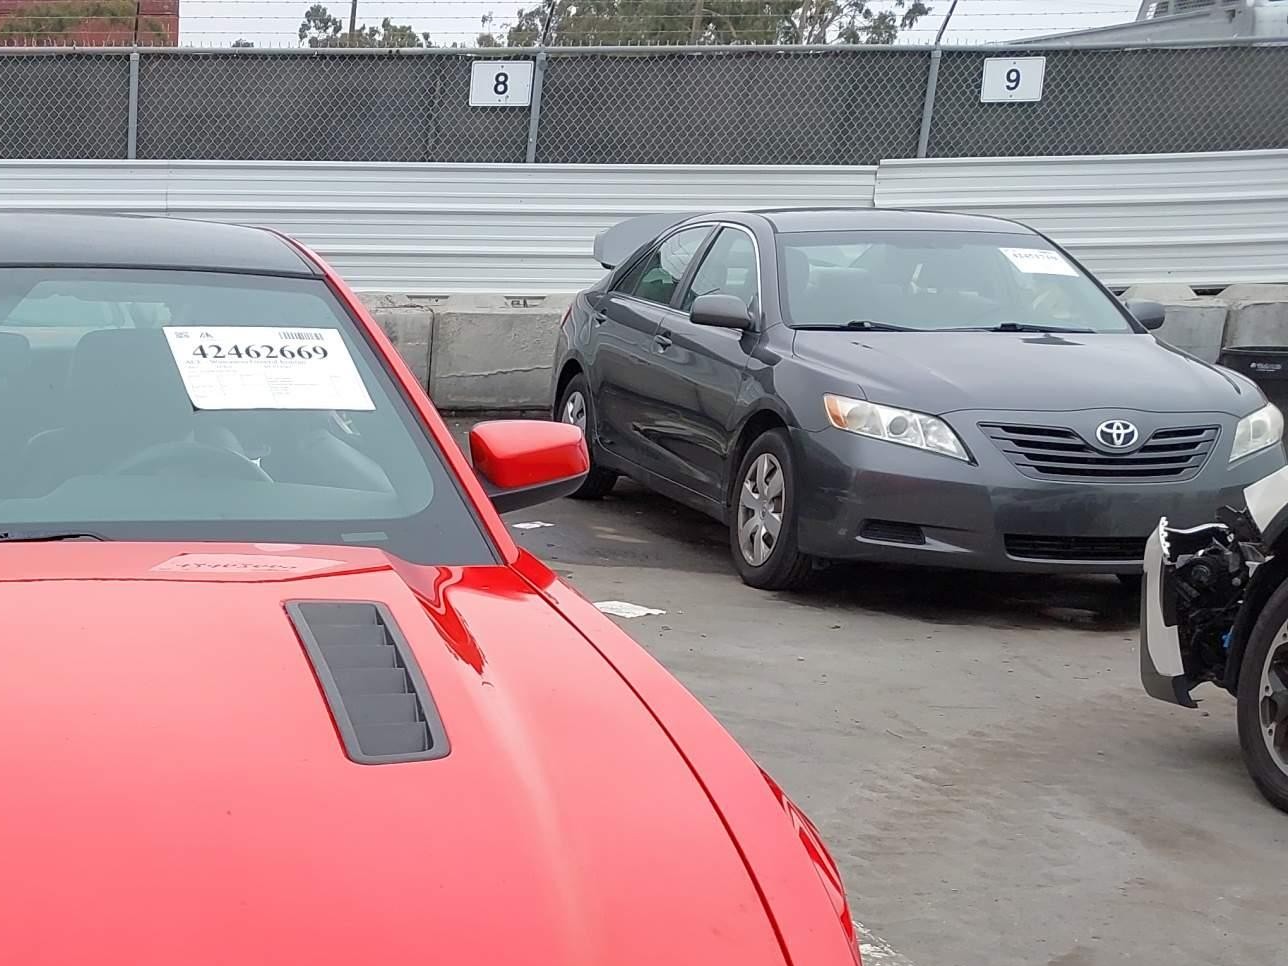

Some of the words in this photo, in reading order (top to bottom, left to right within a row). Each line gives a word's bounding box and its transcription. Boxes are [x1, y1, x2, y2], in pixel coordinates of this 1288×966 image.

[493, 73, 509, 96] 8
[1005, 68, 1021, 91] 9
[192, 344, 328, 360] 42462669
